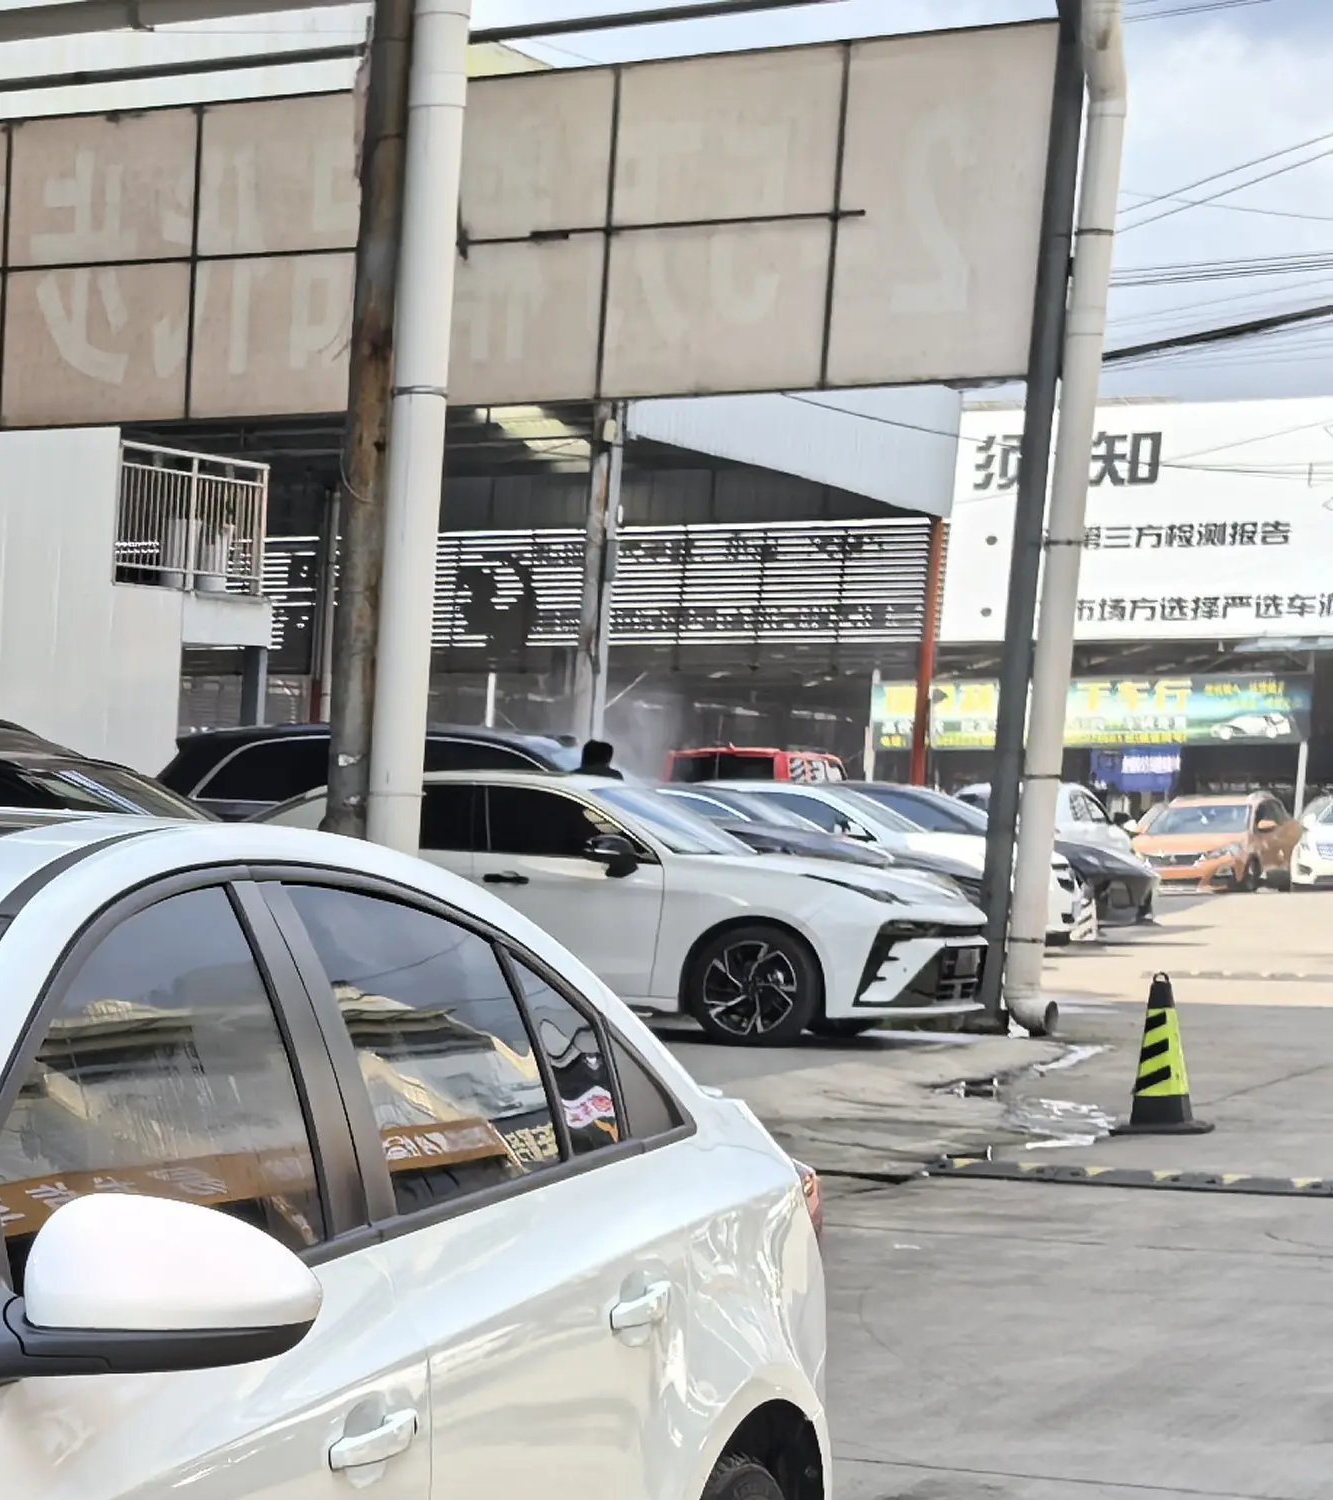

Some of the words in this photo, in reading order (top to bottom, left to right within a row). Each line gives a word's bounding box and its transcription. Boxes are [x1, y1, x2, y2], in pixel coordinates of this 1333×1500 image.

[1042, 520, 1291, 550] 第三方检测报告
